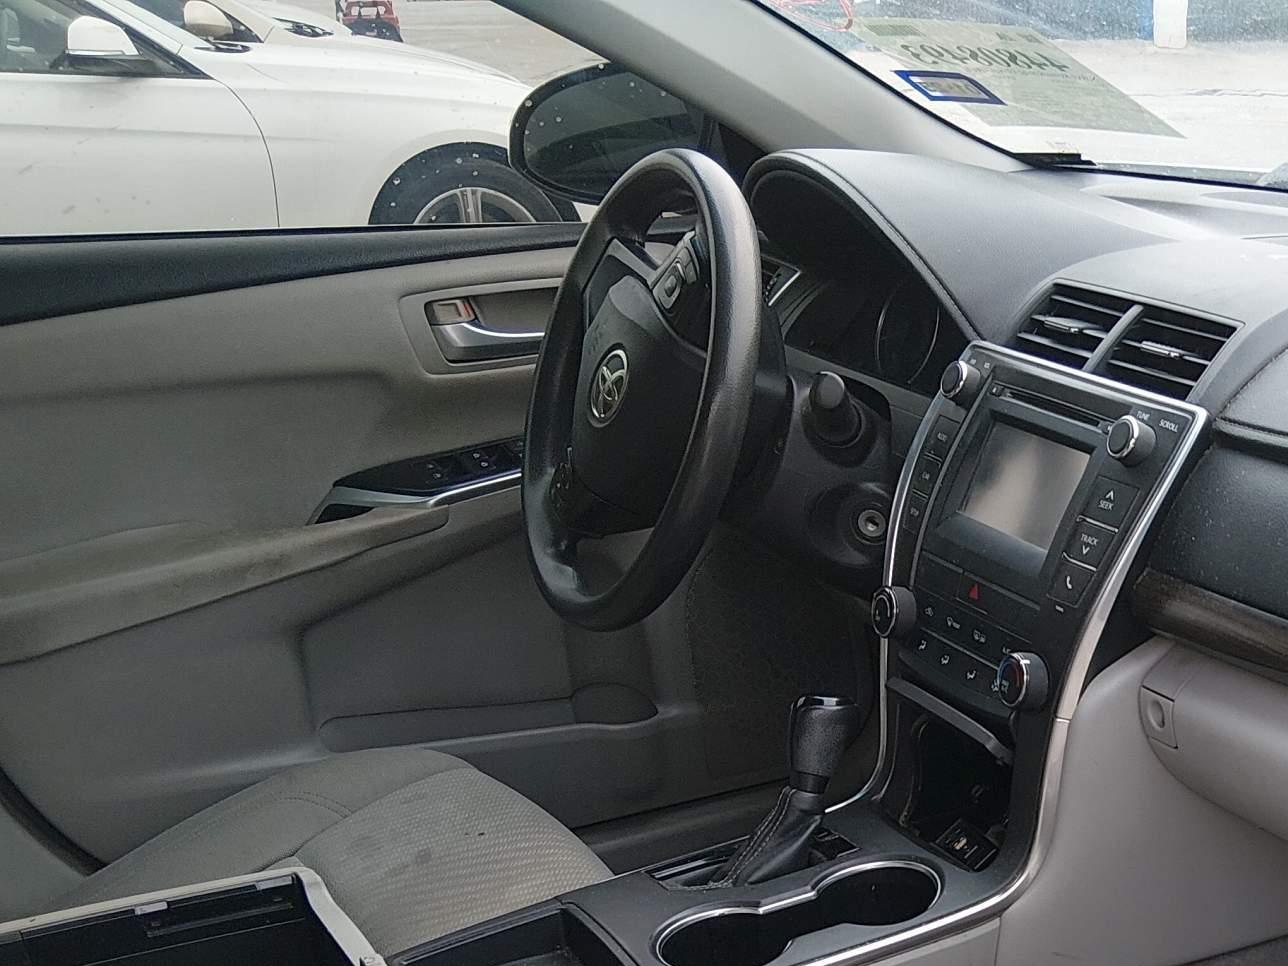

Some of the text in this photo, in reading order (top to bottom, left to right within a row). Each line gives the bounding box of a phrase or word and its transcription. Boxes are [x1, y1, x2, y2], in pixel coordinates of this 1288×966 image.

[1136, 410, 1150, 421] TUNE
[1159, 418, 1179, 433] SCROLL
[1098, 499, 1114, 511] SEEK
[1080, 533, 1099, 546] TRACK
